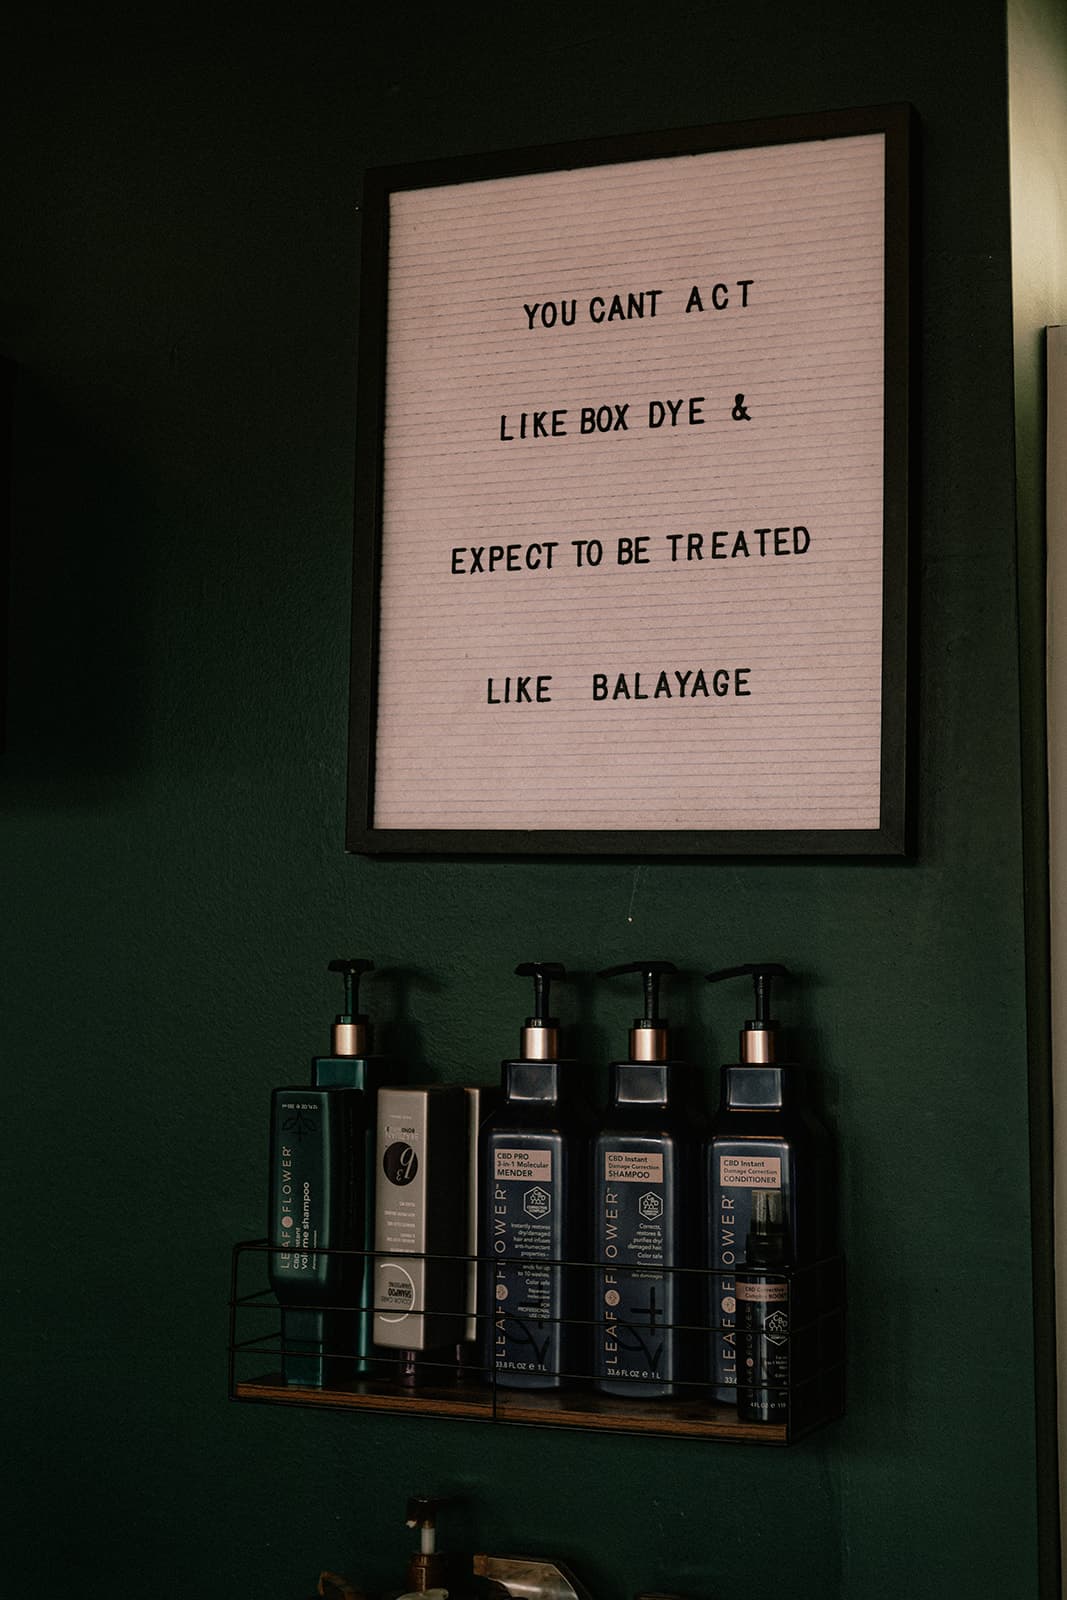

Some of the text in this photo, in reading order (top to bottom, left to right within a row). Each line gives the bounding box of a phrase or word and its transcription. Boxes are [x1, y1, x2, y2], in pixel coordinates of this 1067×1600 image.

[524, 280, 754, 329] YOU CANT ACT
[501, 394, 751, 441] LIKE BOX DYE &
[452, 526, 810, 574] EXPECT TO BE TREATED
[488, 669, 751, 704] LIKE BALAYAGE
[282, 1148, 292, 1212] FLOWER
[497, 1169, 533, 1177] MENDER
[517, 1161, 549, 1169] Molecular
[608, 1170, 650, 1179] SHAMPOO
[723, 1175, 777, 1183] CONDITIONER
[301, 1182, 311, 1270] volme shampoo
[605, 1311, 618, 1364] LEAF
[722, 1318, 736, 1372] LEAF
